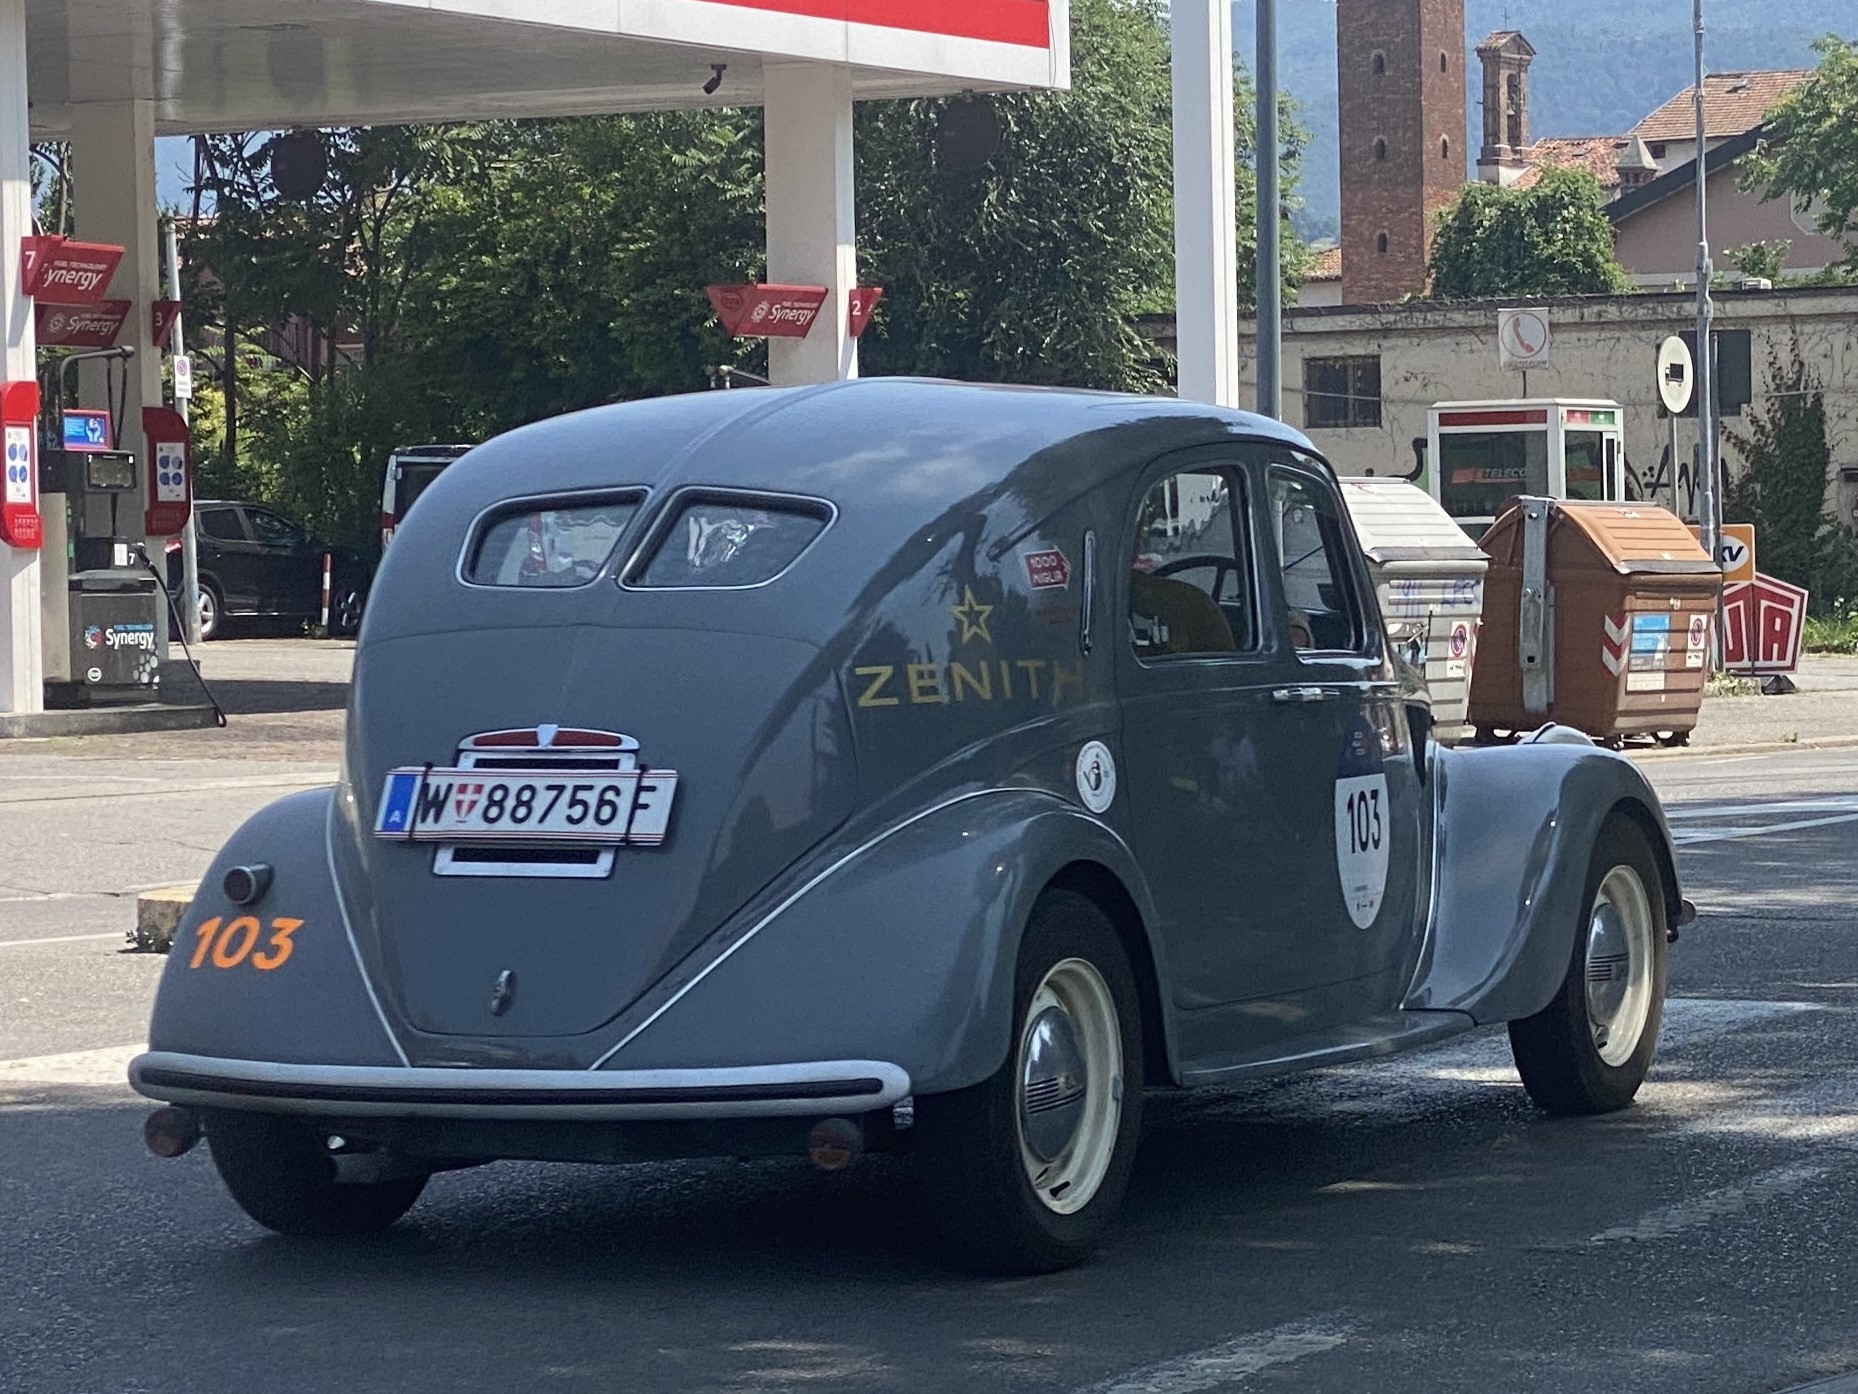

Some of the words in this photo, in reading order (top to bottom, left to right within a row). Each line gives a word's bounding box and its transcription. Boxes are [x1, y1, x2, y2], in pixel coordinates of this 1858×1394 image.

[25, 251, 36, 269] 7
[768, 304, 815, 325] Synergy
[852, 300, 861, 315] 2
[66, 316, 119, 335] Synergy
[155, 312, 162, 326] 3
[1486, 468, 1528, 478] TELECO
[128, 552, 136, 565] 7
[1030, 555, 1057, 568] 1000
[105, 628, 155, 650] Synergy
[854, 660, 1085, 707] ZENITH
[388, 809, 402, 823] A
[1347, 788, 1381, 854] 103
[189, 915, 304, 970] 103
